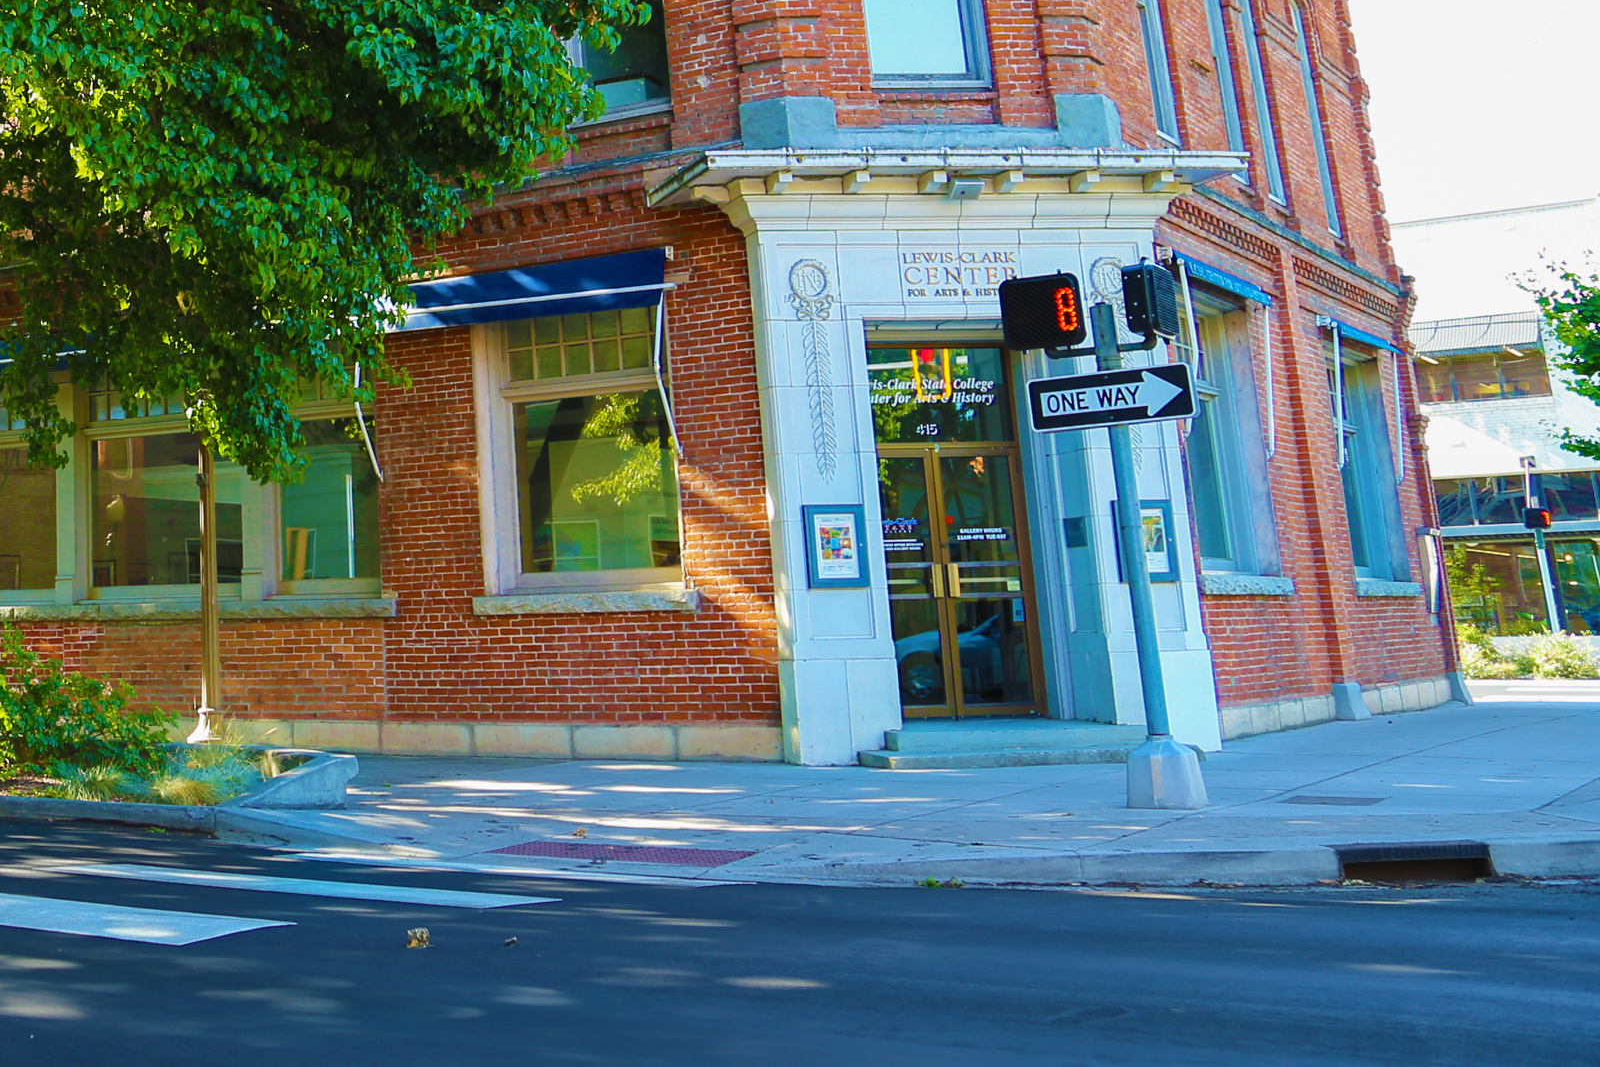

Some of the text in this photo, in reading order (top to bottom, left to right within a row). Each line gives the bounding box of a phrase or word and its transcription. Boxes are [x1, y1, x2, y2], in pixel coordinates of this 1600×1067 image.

[902, 251, 1016, 264] LEWIS-CLARK
[904, 266, 1017, 285] CENTER
[907, 287, 1000, 297] FOR ARTS & HIST
[1053, 286, 1080, 332] 8
[869, 378, 994, 392] is-Clark State College
[891, 392, 912, 407] for
[914, 393, 938, 404] Arts
[941, 393, 950, 403] &
[951, 392, 995, 406] History
[1047, 385, 1140, 413] ONE WAY
[916, 423, 938, 435] 415
